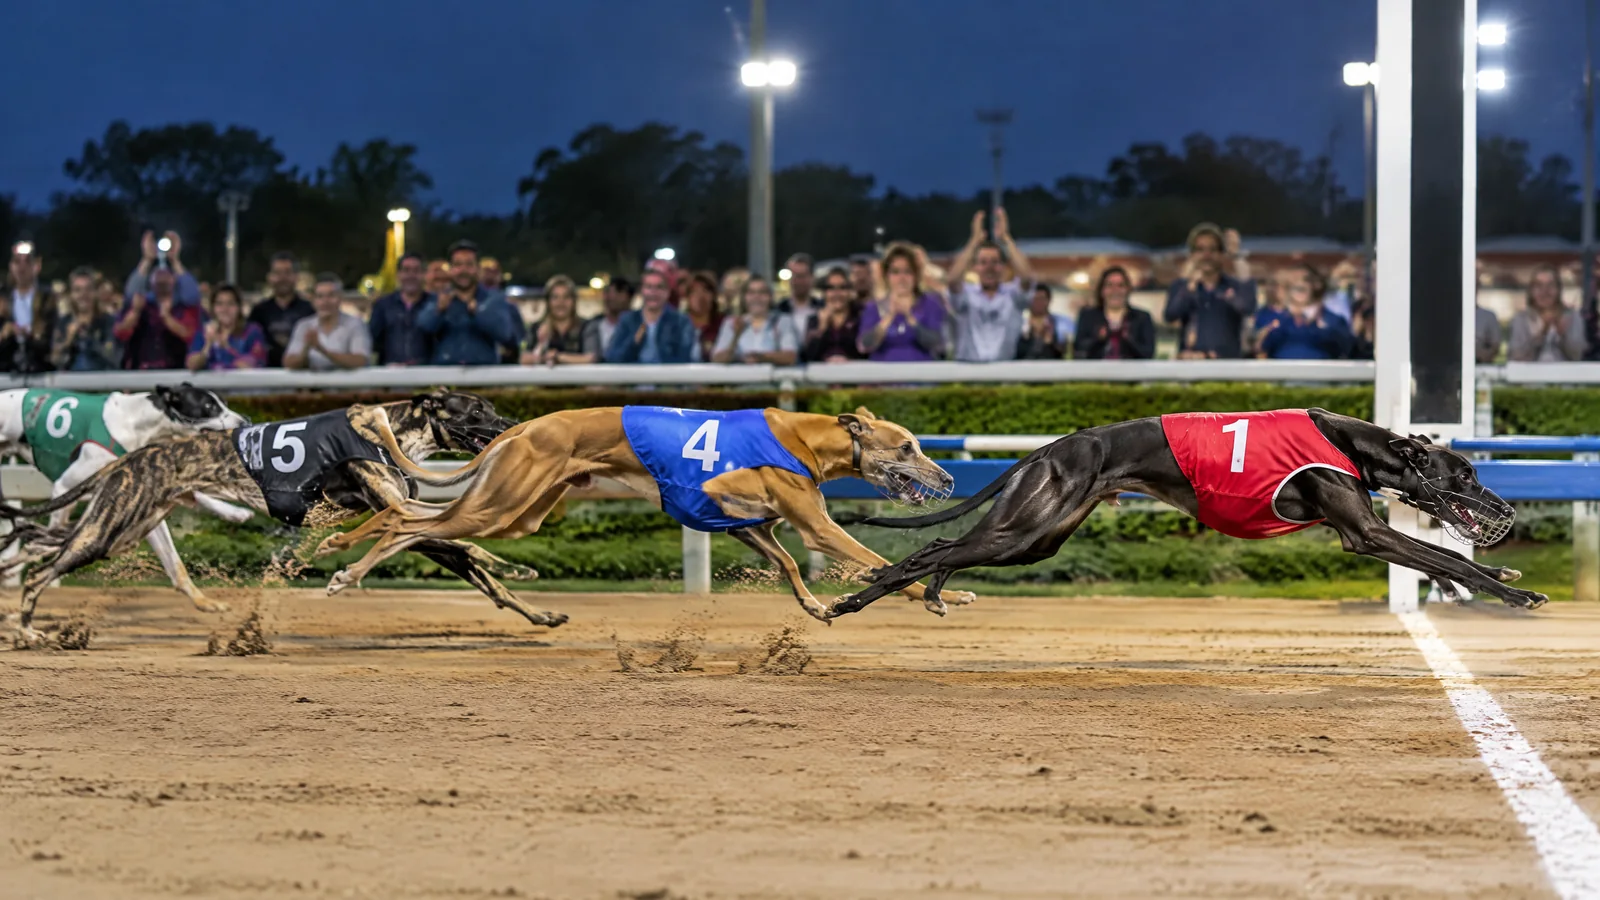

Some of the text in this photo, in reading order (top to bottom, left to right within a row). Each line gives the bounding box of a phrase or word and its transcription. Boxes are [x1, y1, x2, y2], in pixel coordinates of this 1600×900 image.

[46, 396, 79, 438] 6
[271, 421, 307, 473] 5
[682, 419, 720, 472] 4
[1222, 419, 1249, 473] 1
